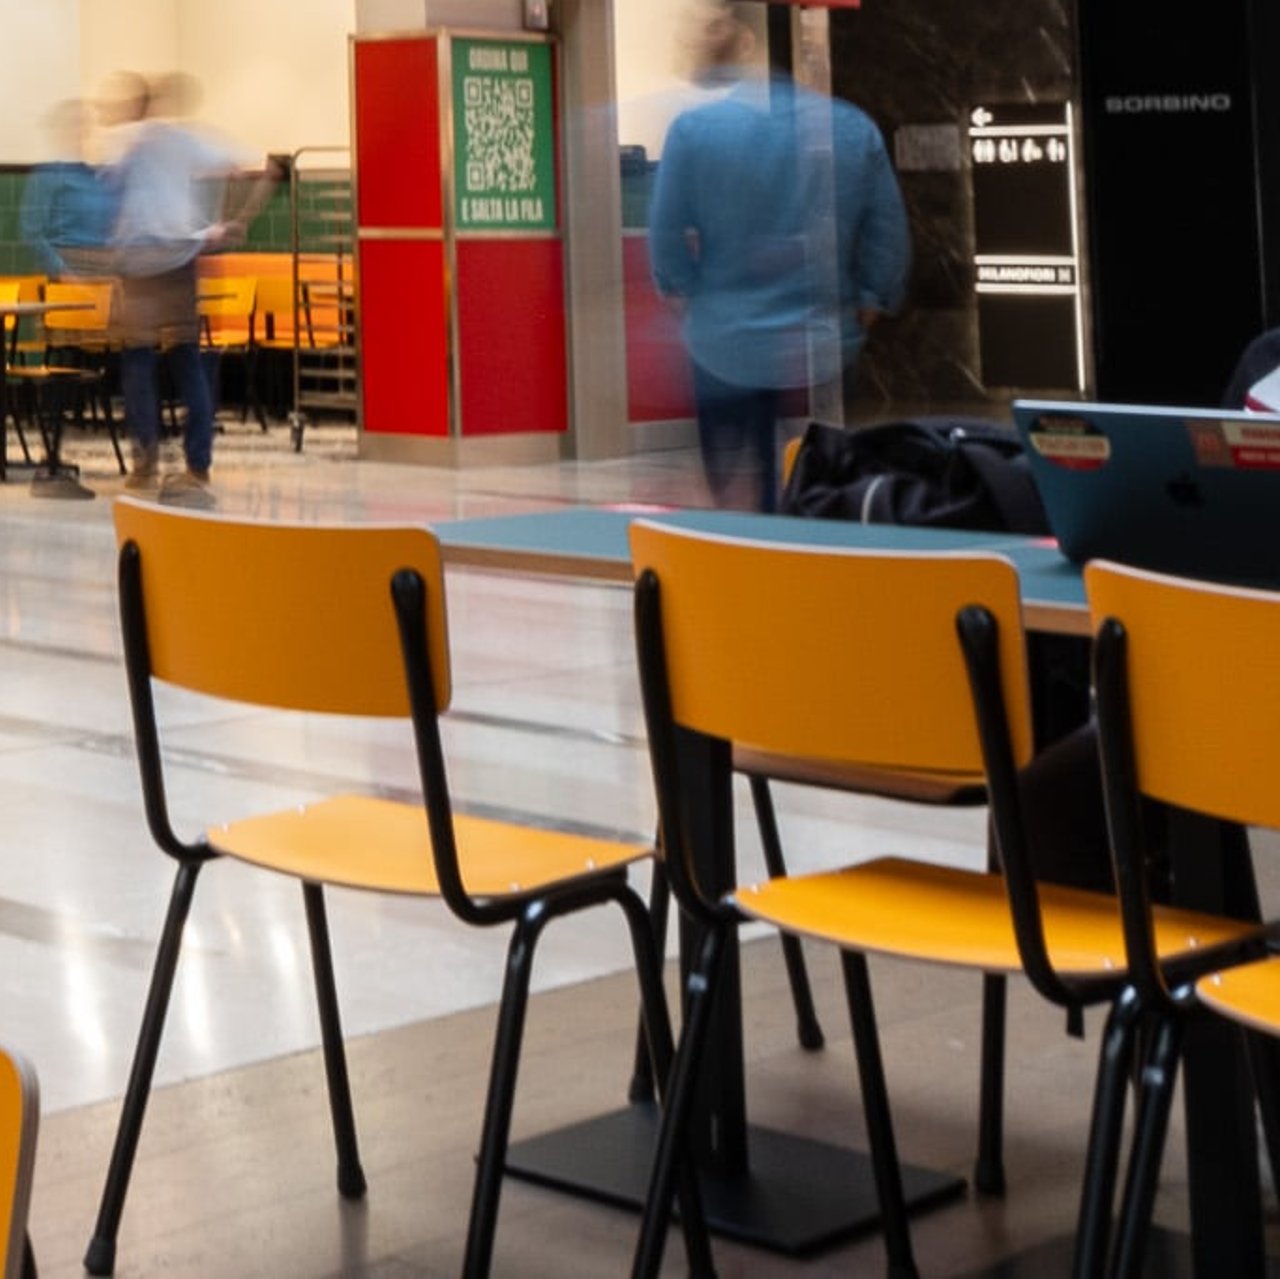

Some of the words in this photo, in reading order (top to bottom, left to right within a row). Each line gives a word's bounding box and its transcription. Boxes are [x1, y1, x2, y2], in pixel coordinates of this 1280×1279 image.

[510, 49, 529, 73] QUI
[1105, 94, 1232, 114] SORBINO
[461, 199, 468, 223] E
[471, 199, 503, 222] SALTA
[505, 200, 519, 222] LA
[521, 199, 544, 223] FILA
